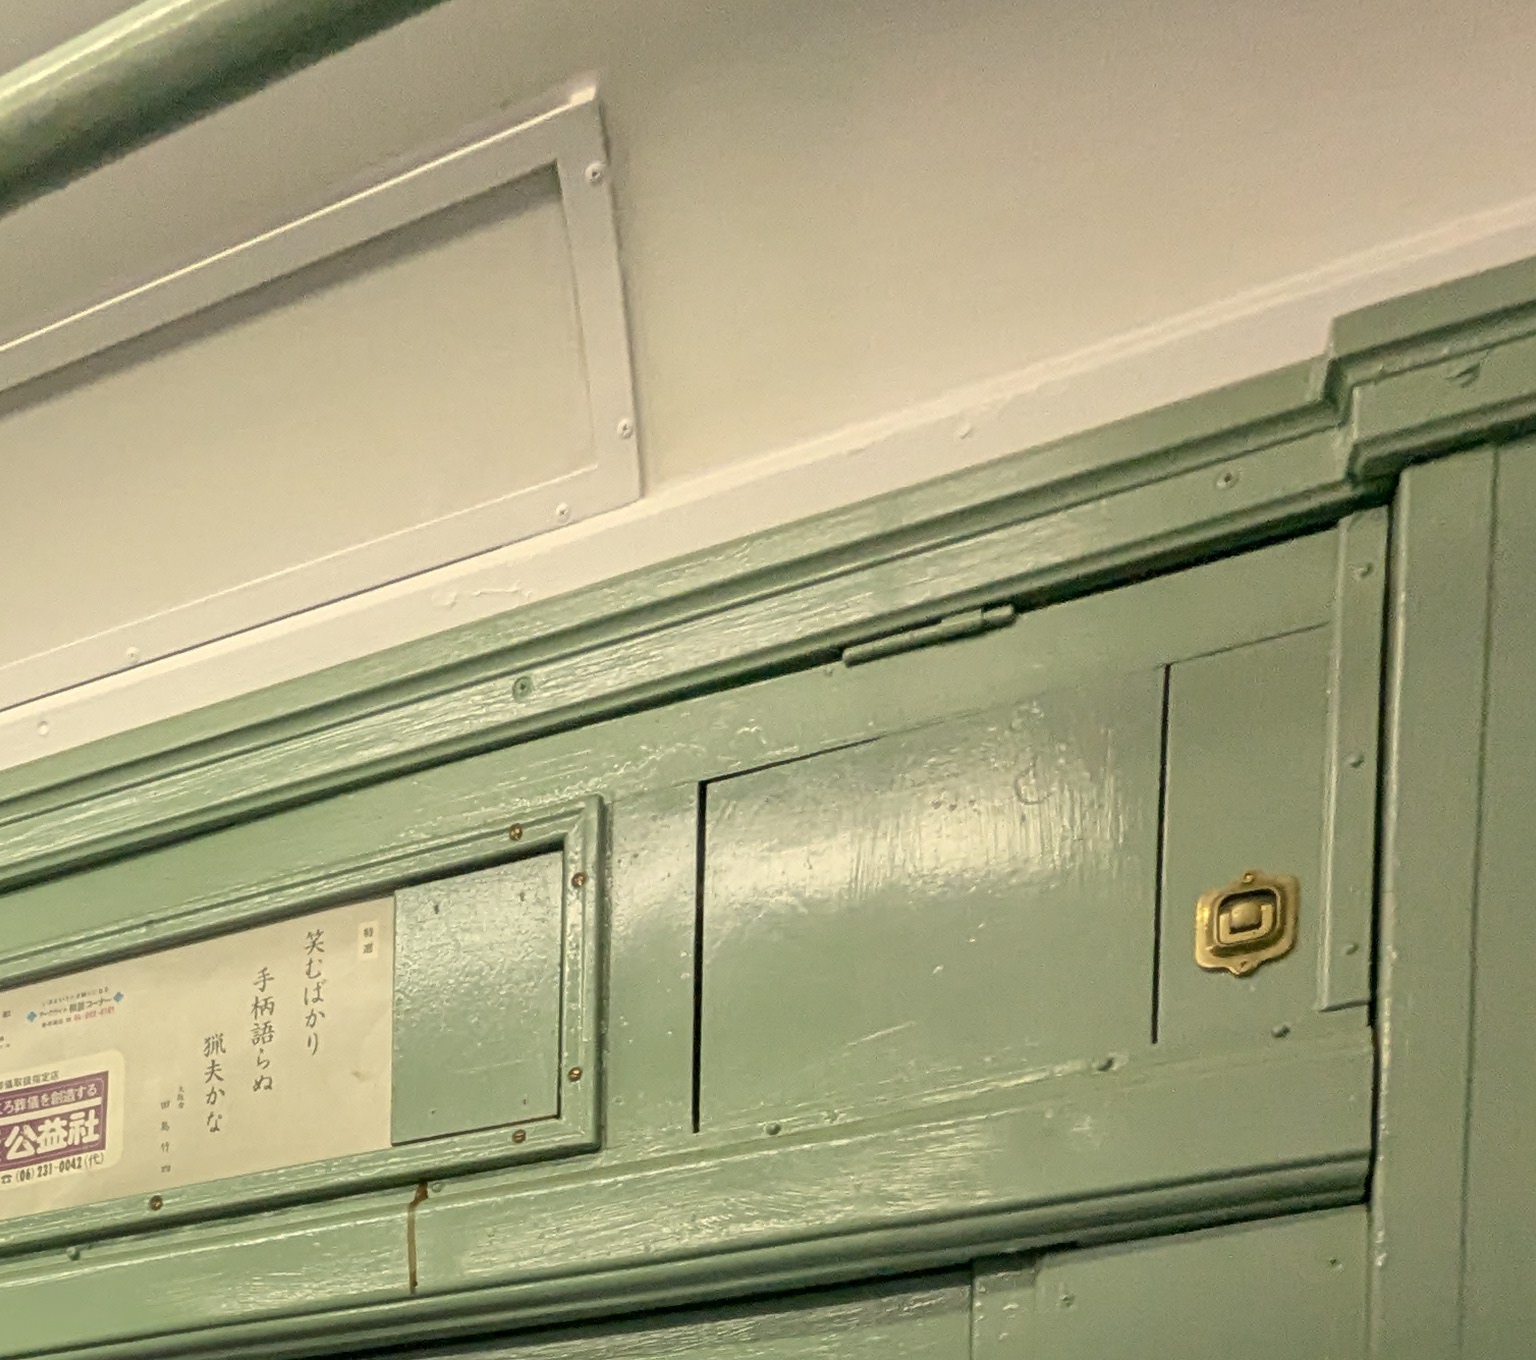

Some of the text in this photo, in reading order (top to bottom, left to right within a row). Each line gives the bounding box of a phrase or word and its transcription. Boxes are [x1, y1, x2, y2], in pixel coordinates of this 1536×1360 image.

[250, 966, 276, 1092] 手柄語らぬ
[303, 929, 327, 1056] 笑むばかり
[4, 1109, 101, 1161] 公益社
[203, 1033, 227, 1133] 猟夫かな
